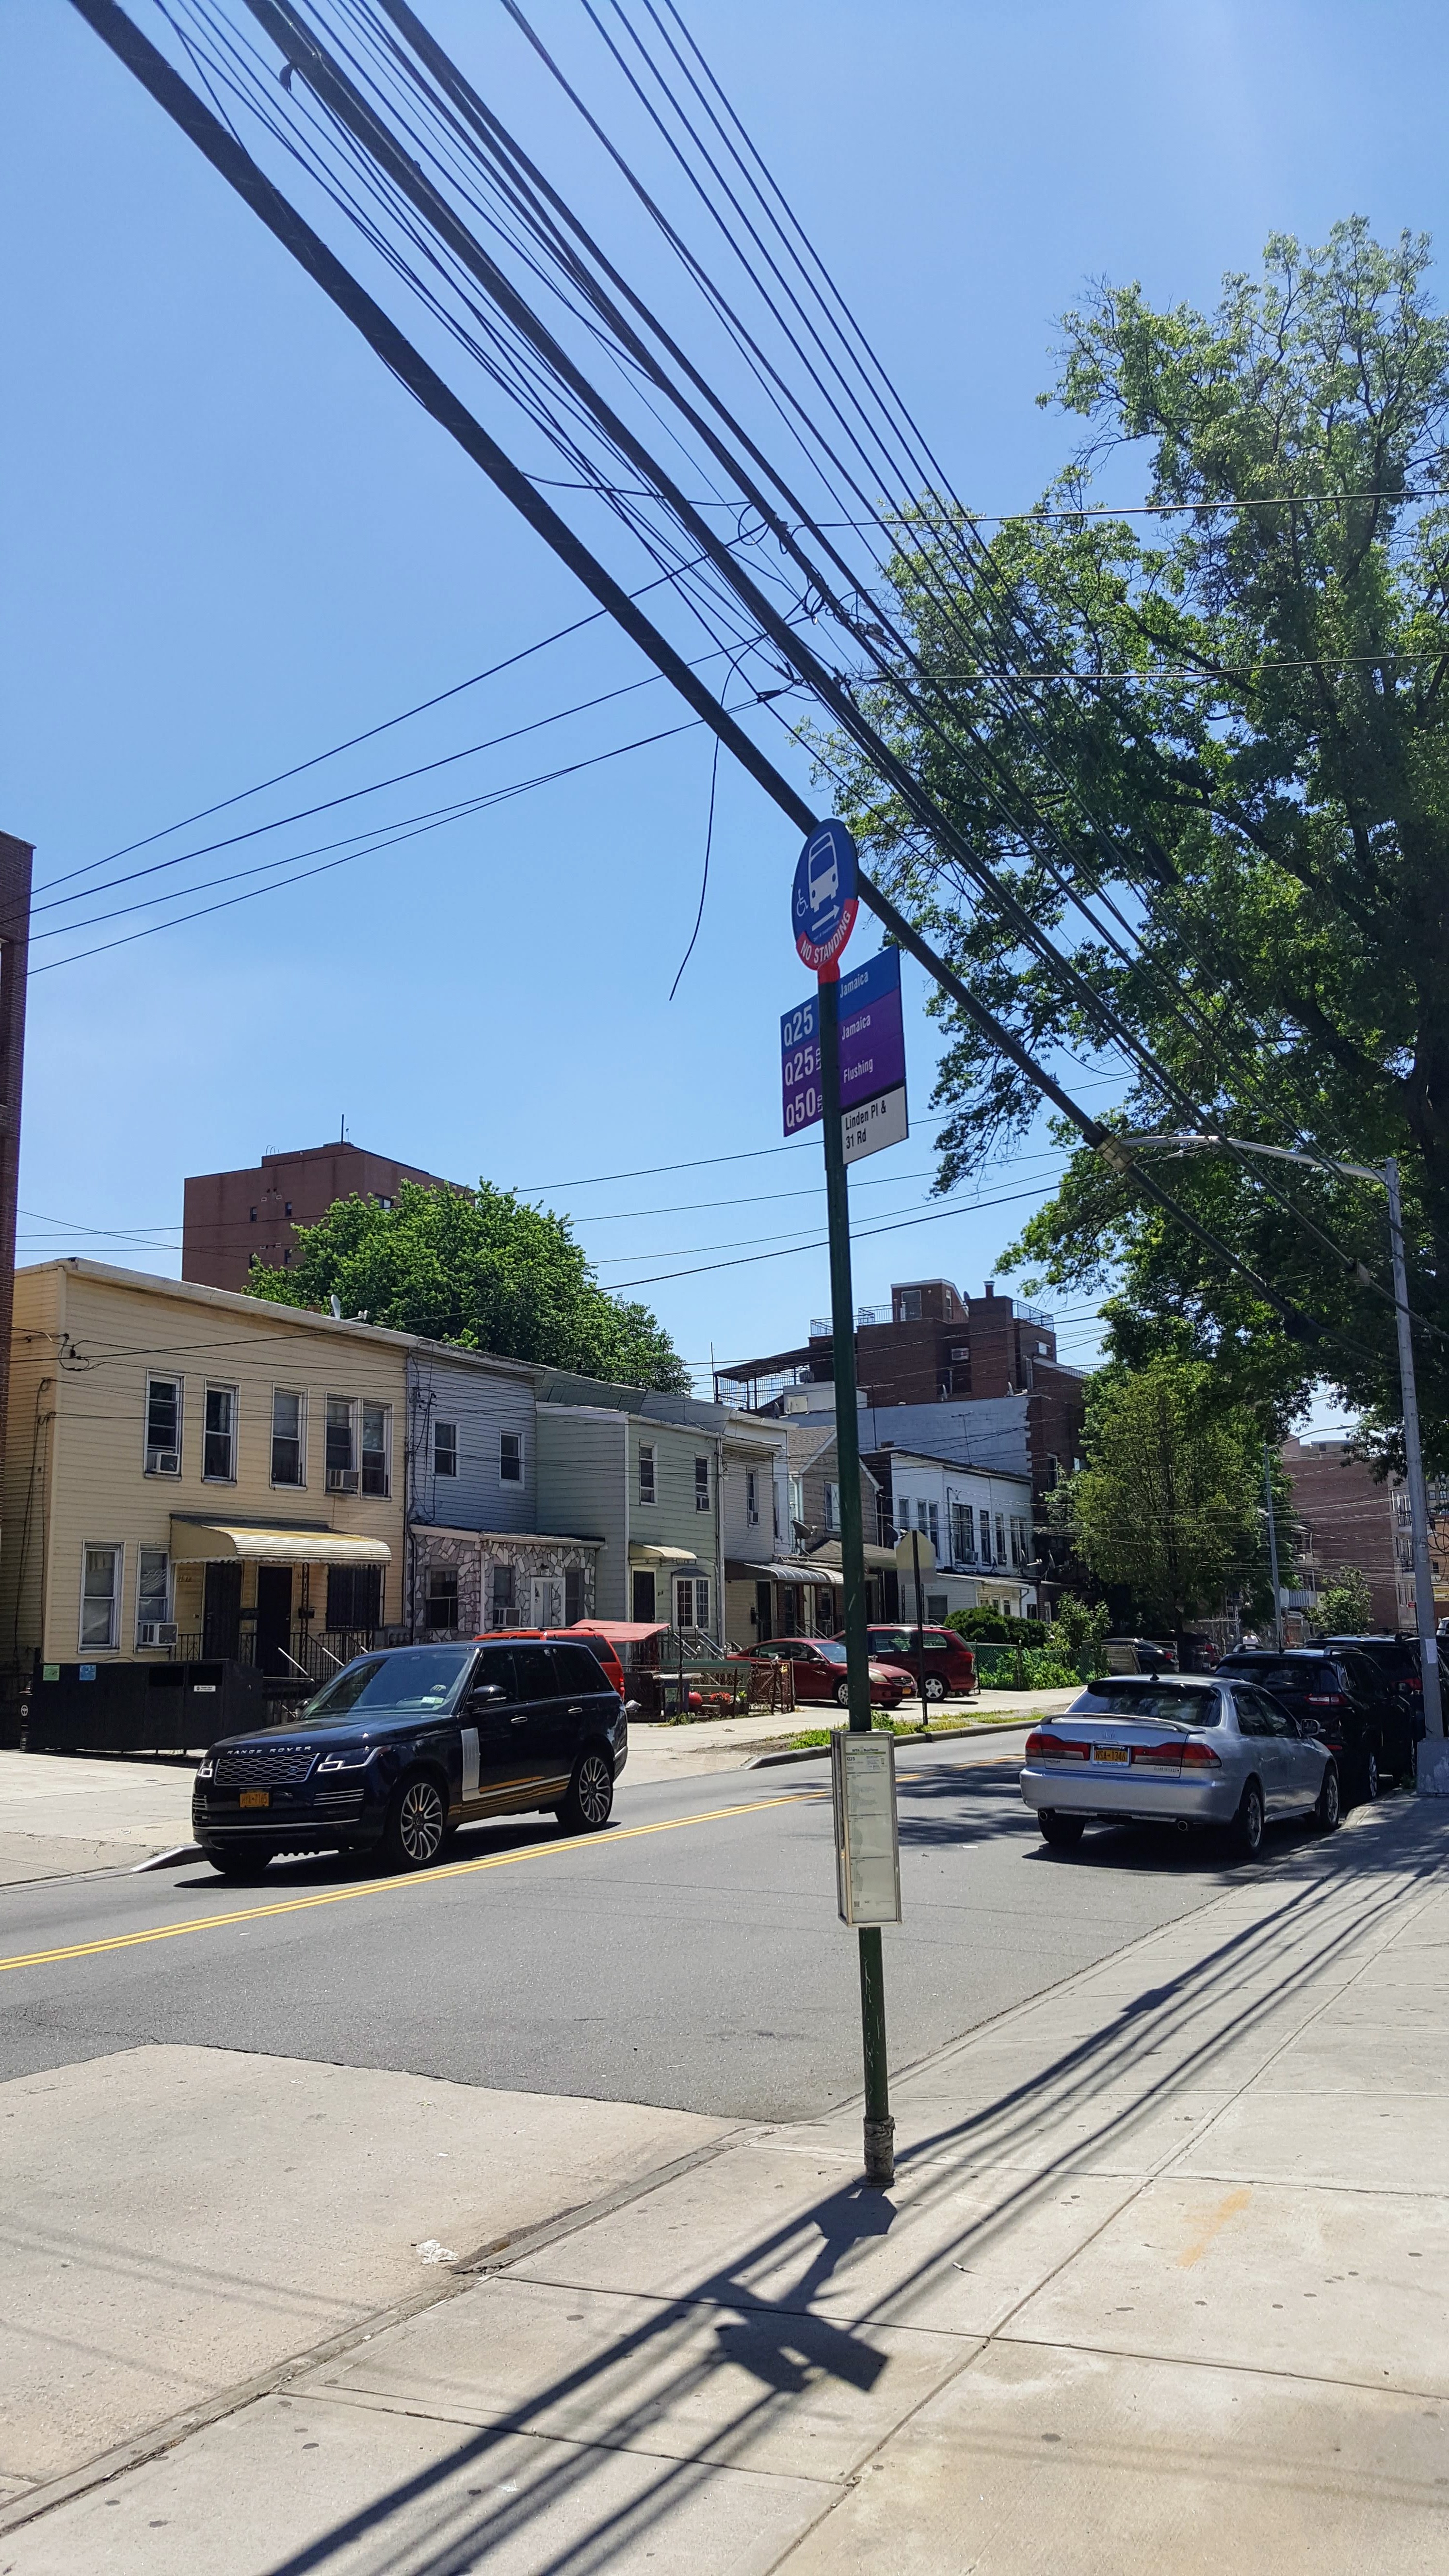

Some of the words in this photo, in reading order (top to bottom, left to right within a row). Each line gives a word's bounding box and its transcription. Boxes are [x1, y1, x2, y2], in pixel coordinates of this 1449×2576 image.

[801, 940, 812, 961] NO
[814, 910, 851, 964] STANDING
[784, 1004, 813, 1047] Q25
[840, 971, 869, 998] Jamaica
[785, 1046, 814, 1086] Q25
[841, 1015, 871, 1041] Jamaica
[786, 1087, 816, 1128] Q50
[843, 1059, 873, 1083] Flushing
[845, 1111, 869, 1131] Linden
[871, 1103, 878, 1119] Pl
[881, 1100, 886, 1114] &
[846, 1134, 854, 1149] 31
[857, 1128, 867, 1145] Rd
